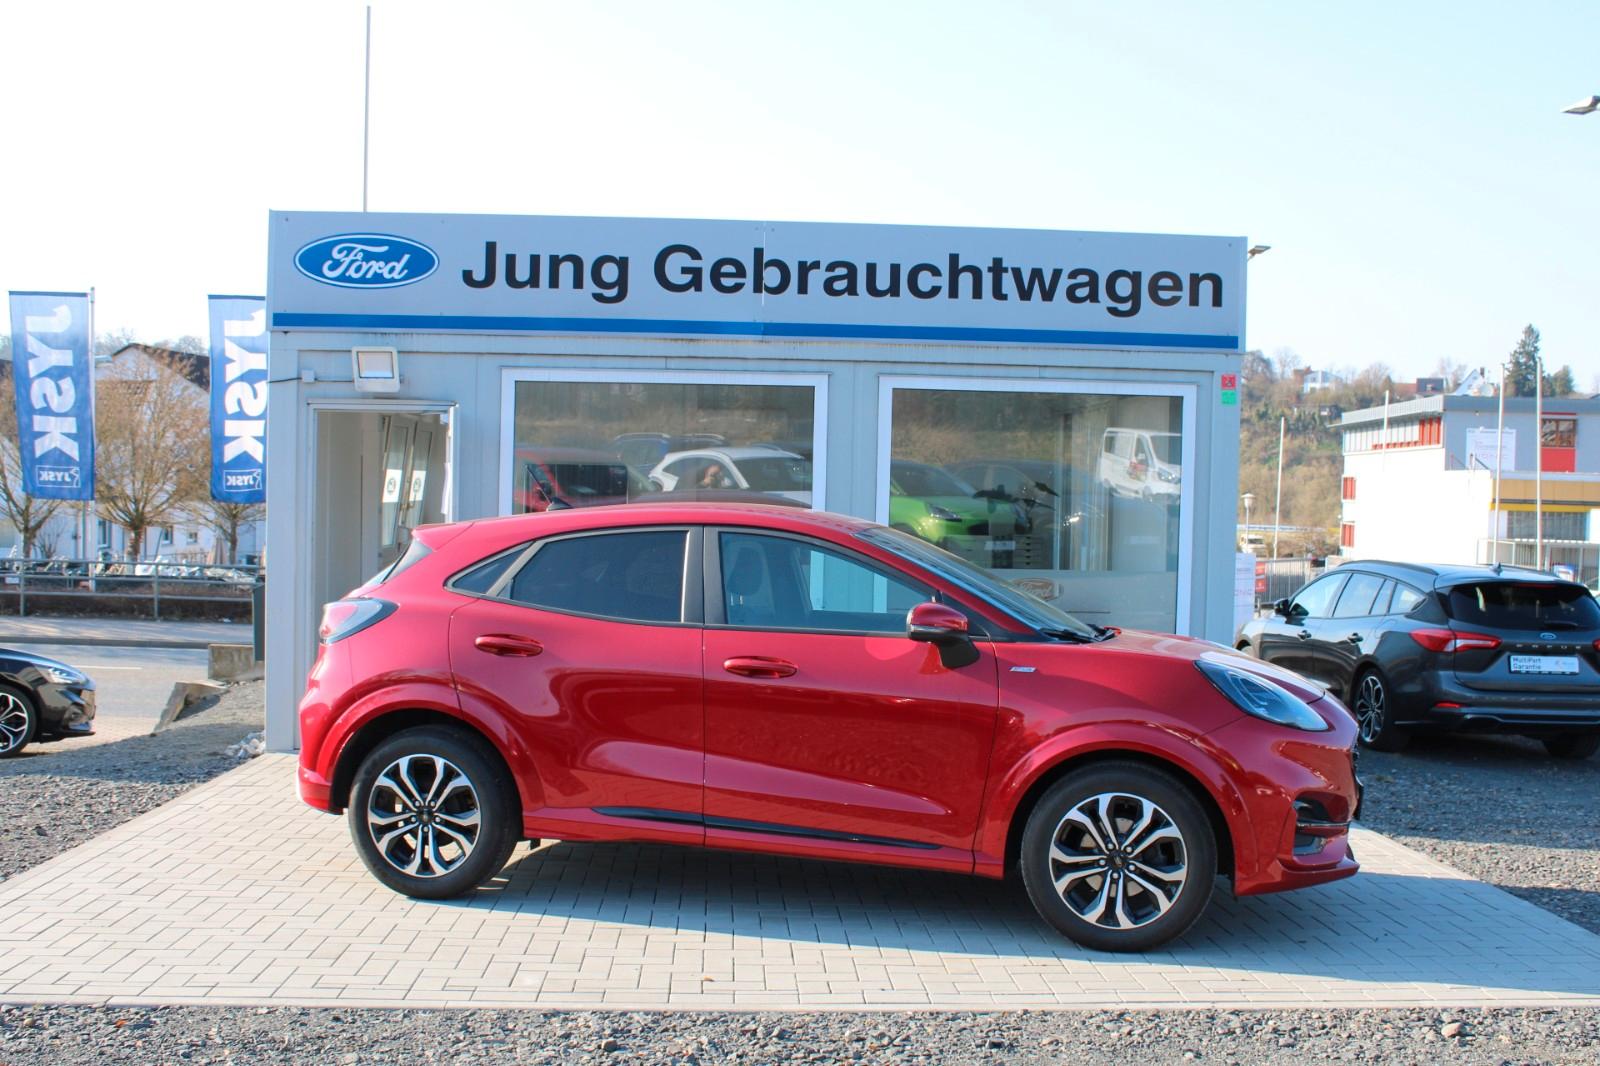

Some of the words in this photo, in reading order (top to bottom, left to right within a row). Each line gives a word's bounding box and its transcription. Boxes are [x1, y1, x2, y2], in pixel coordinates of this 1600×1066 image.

[322, 242, 411, 280] Ford
[462, 241, 629, 304] Jung
[653, 243, 1223, 318] Gebrauchtwagen
